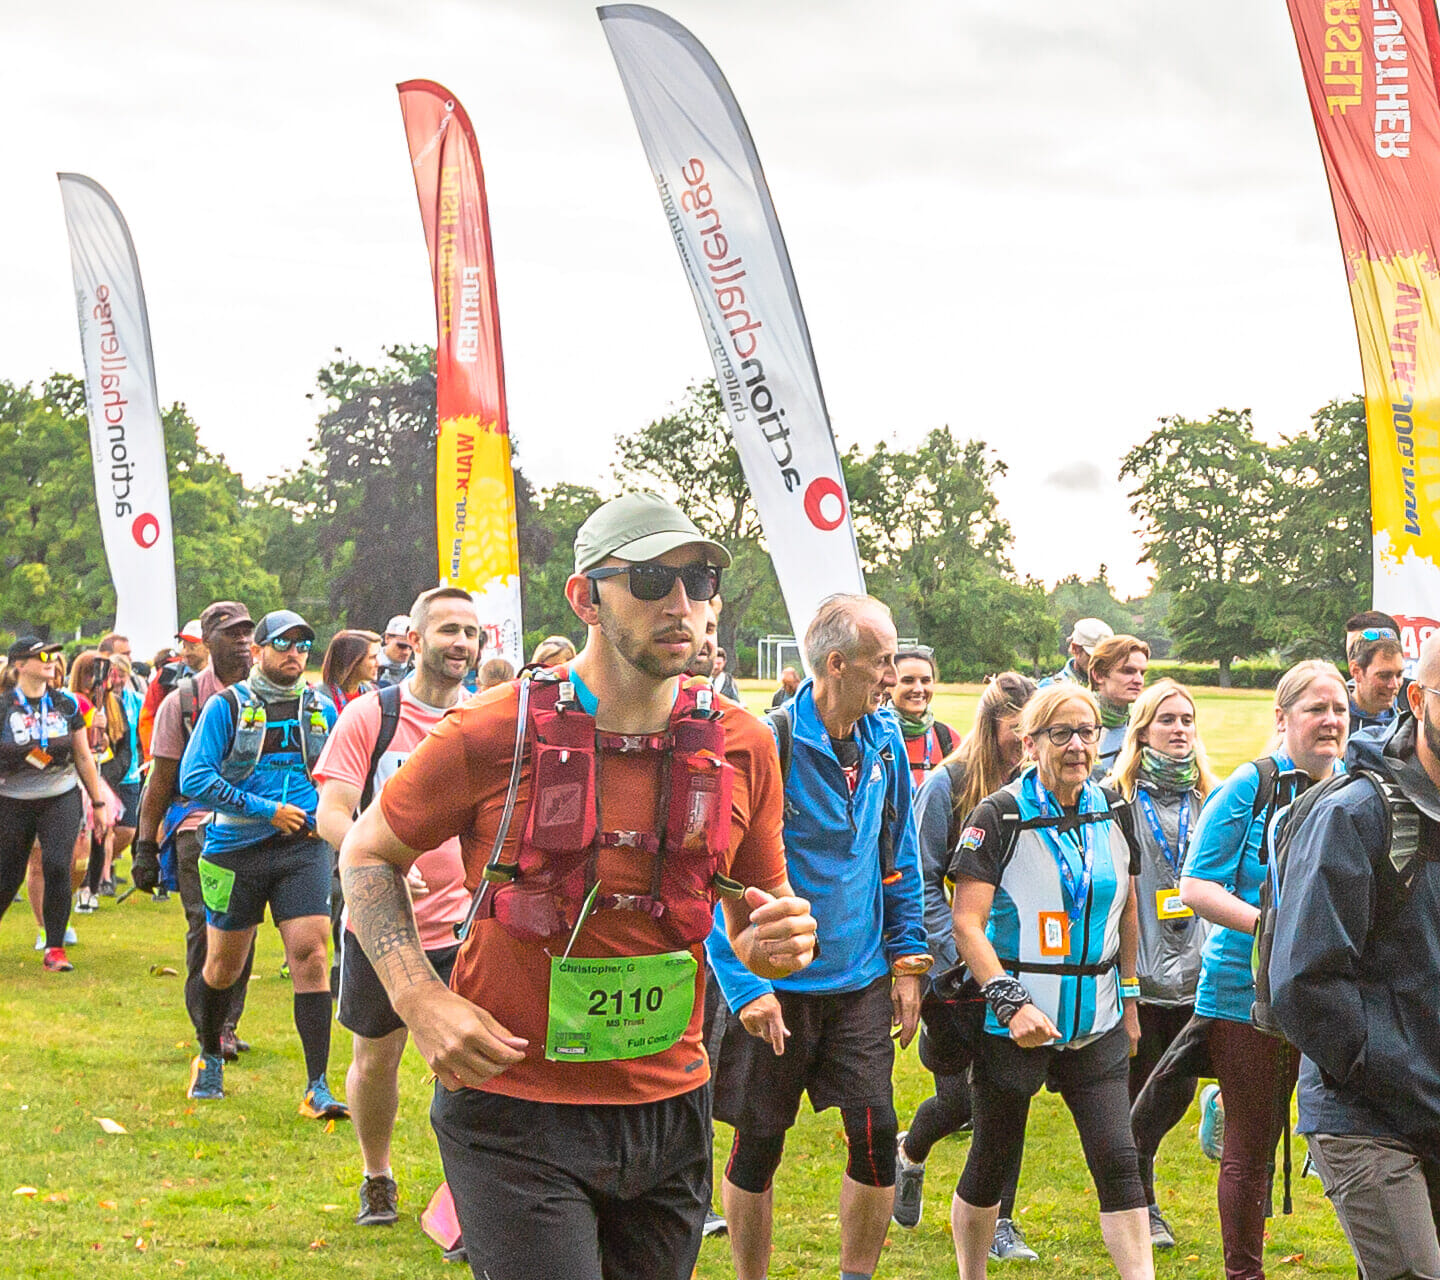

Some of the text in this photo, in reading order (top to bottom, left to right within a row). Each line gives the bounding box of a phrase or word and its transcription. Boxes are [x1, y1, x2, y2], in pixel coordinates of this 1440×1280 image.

[626, 963, 636, 972] G
[588, 986, 664, 1016] 2110
[606, 1019, 620, 1027] MS
[627, 1037, 645, 1048] Full
